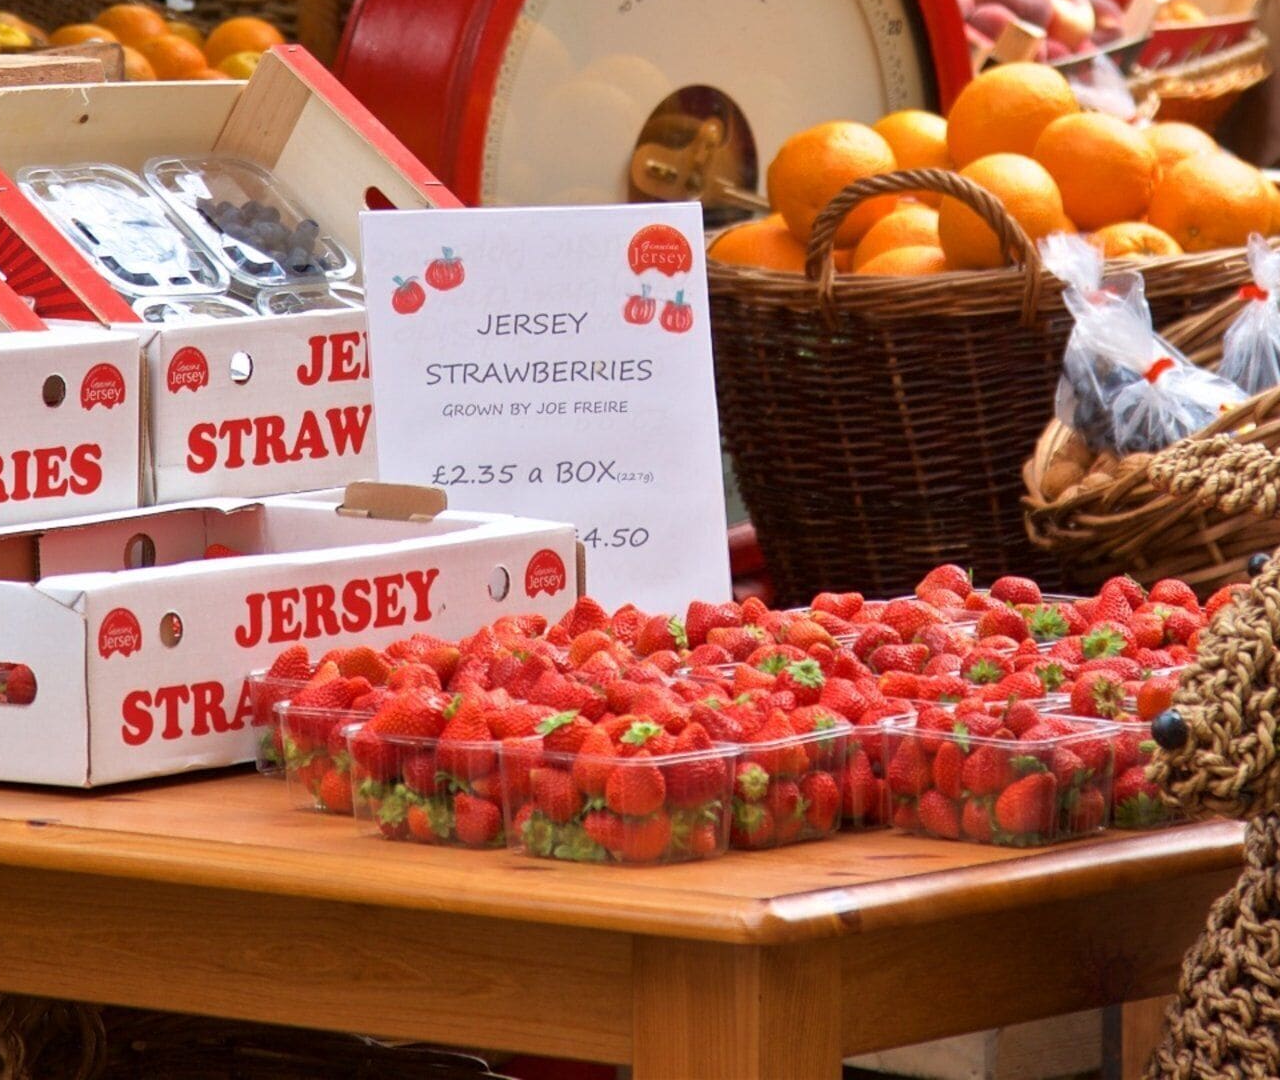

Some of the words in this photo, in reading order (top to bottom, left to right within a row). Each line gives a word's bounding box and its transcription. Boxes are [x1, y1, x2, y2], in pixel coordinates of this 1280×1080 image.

[632, 247, 687, 270] Jersey
[476, 311, 588, 336] JERSEY
[296, 331, 369, 386] JE
[170, 370, 205, 385] Jersey
[426, 358, 653, 386] STRAWBERRIES
[442, 402, 504, 417] GROWN
[510, 402, 532, 416] BY
[536, 401, 567, 415] JOE
[574, 400, 629, 414] FREIRE
[186, 404, 372, 474] STRAW
[432, 464, 517, 486] £2.35
[528, 467, 543, 484] a
[527, 573, 563, 589] Jersey
[234, 568, 440, 649] JERSEY
[102, 633, 138, 649] Jersey
